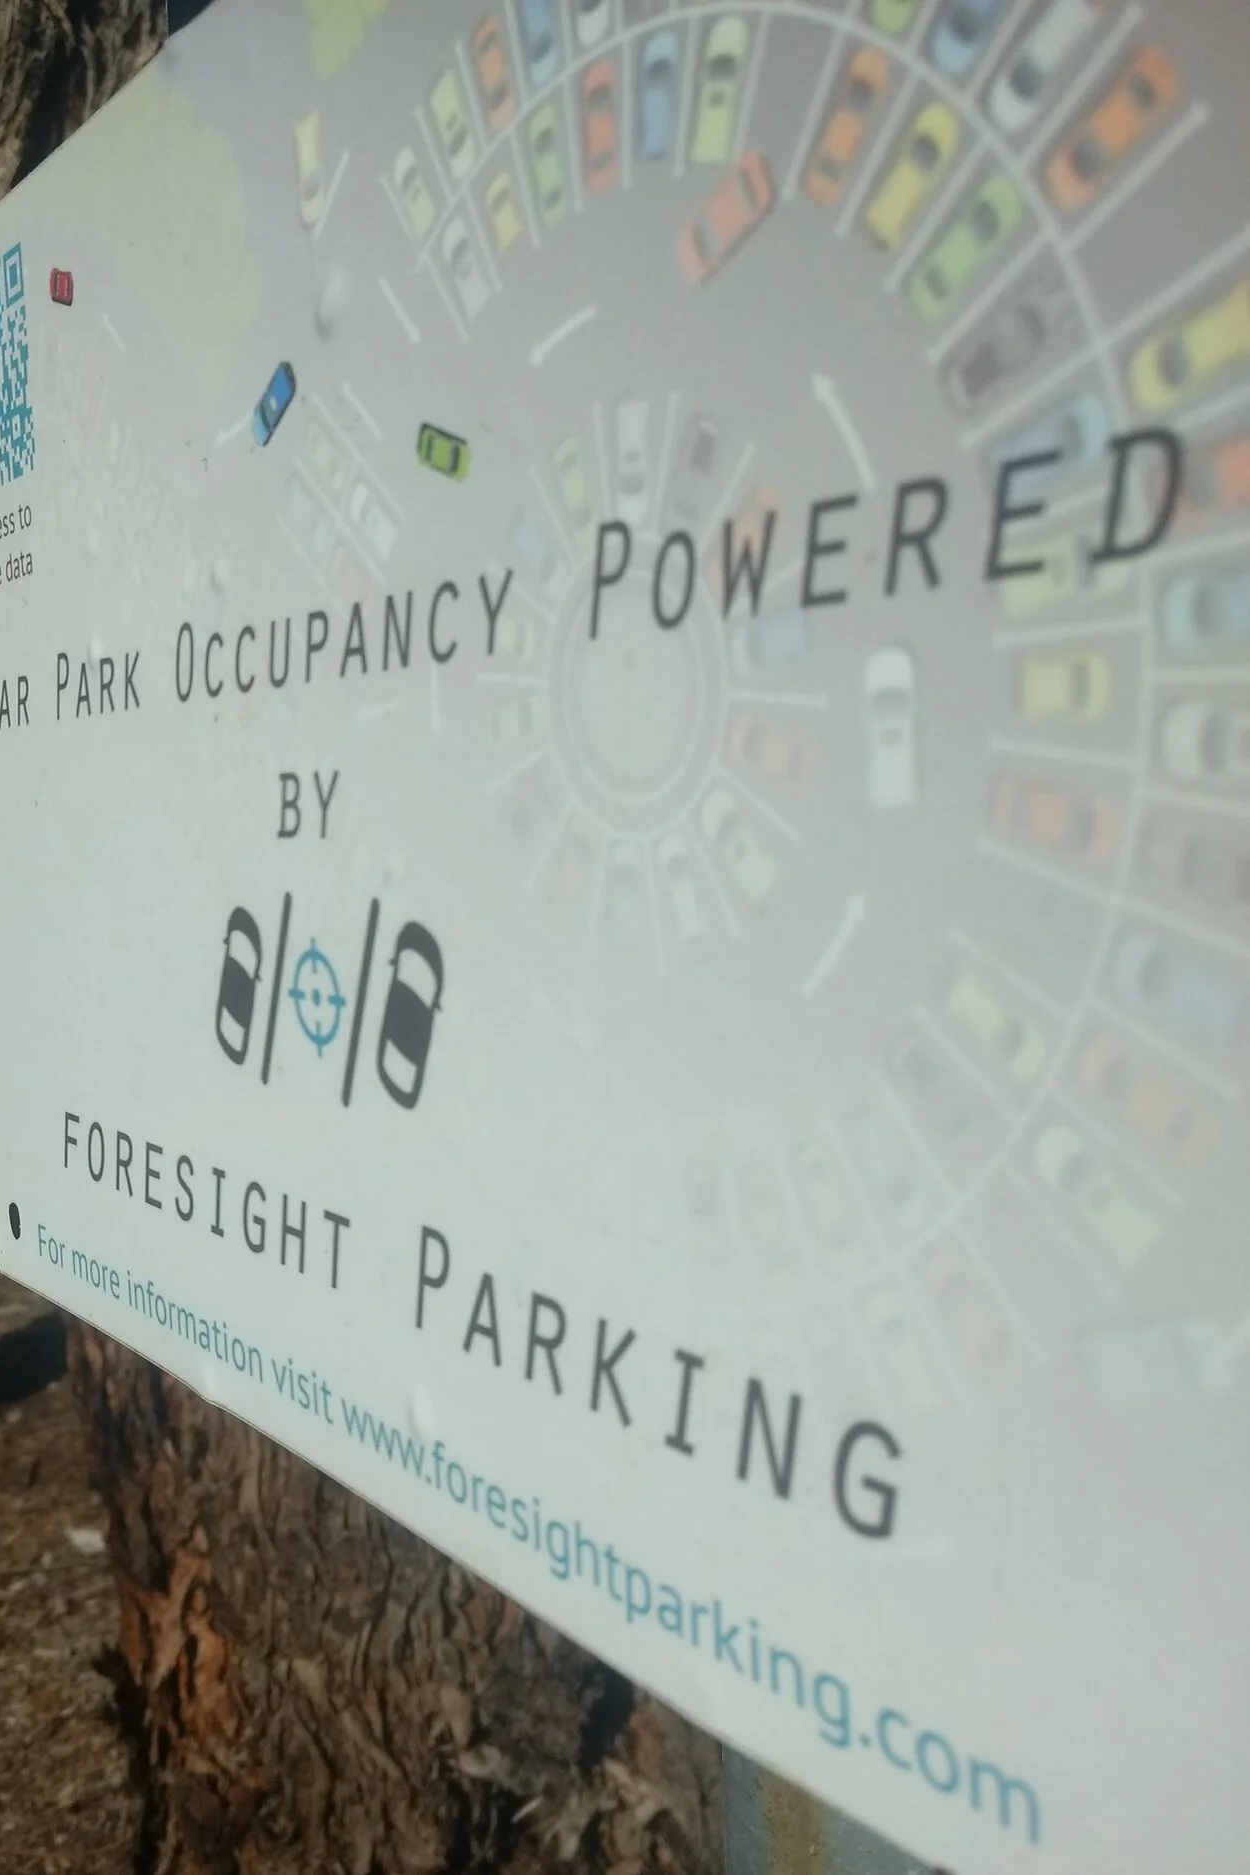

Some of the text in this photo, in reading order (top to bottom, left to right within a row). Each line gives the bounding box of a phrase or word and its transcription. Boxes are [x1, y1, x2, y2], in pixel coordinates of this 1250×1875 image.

[5, 552, 33, 582] data
[18, 504, 32, 530] to
[56, 652, 141, 721] PARK
[175, 568, 514, 703] OCCUPANCY
[589, 427, 1184, 640] POWERED
[277, 769, 340, 839] BY
[62, 1112, 903, 1540] FORESIGHT PARKING
[37, 1223, 1044, 1846] For more information visit www.foresightparking.com
